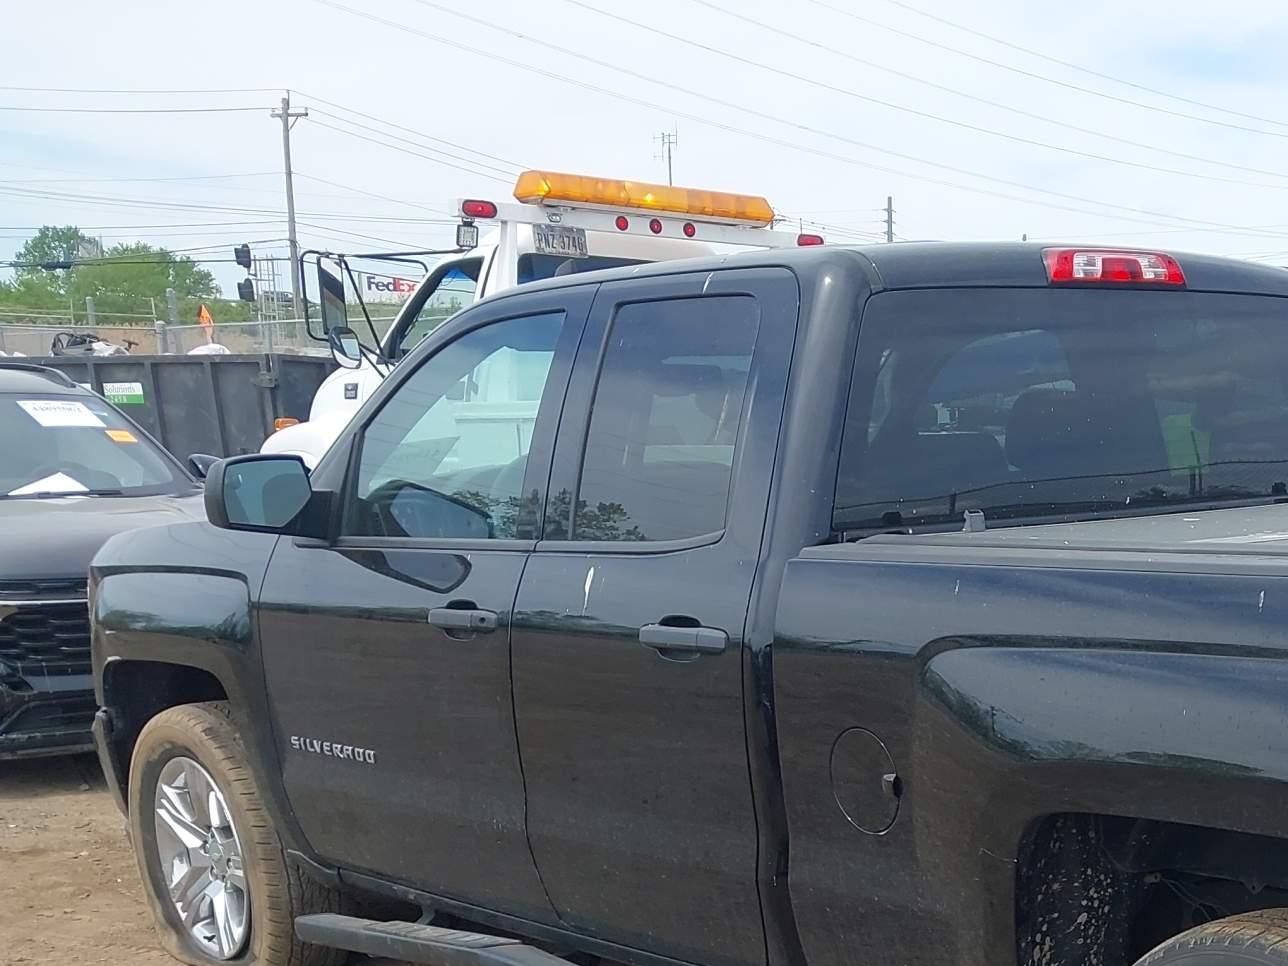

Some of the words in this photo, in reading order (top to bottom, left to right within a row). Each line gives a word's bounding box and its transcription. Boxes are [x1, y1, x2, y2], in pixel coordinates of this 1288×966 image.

[537, 232, 556, 249] PNZ
[366, 276, 418, 293] FedEx
[290, 735, 376, 764] SILVERADO
